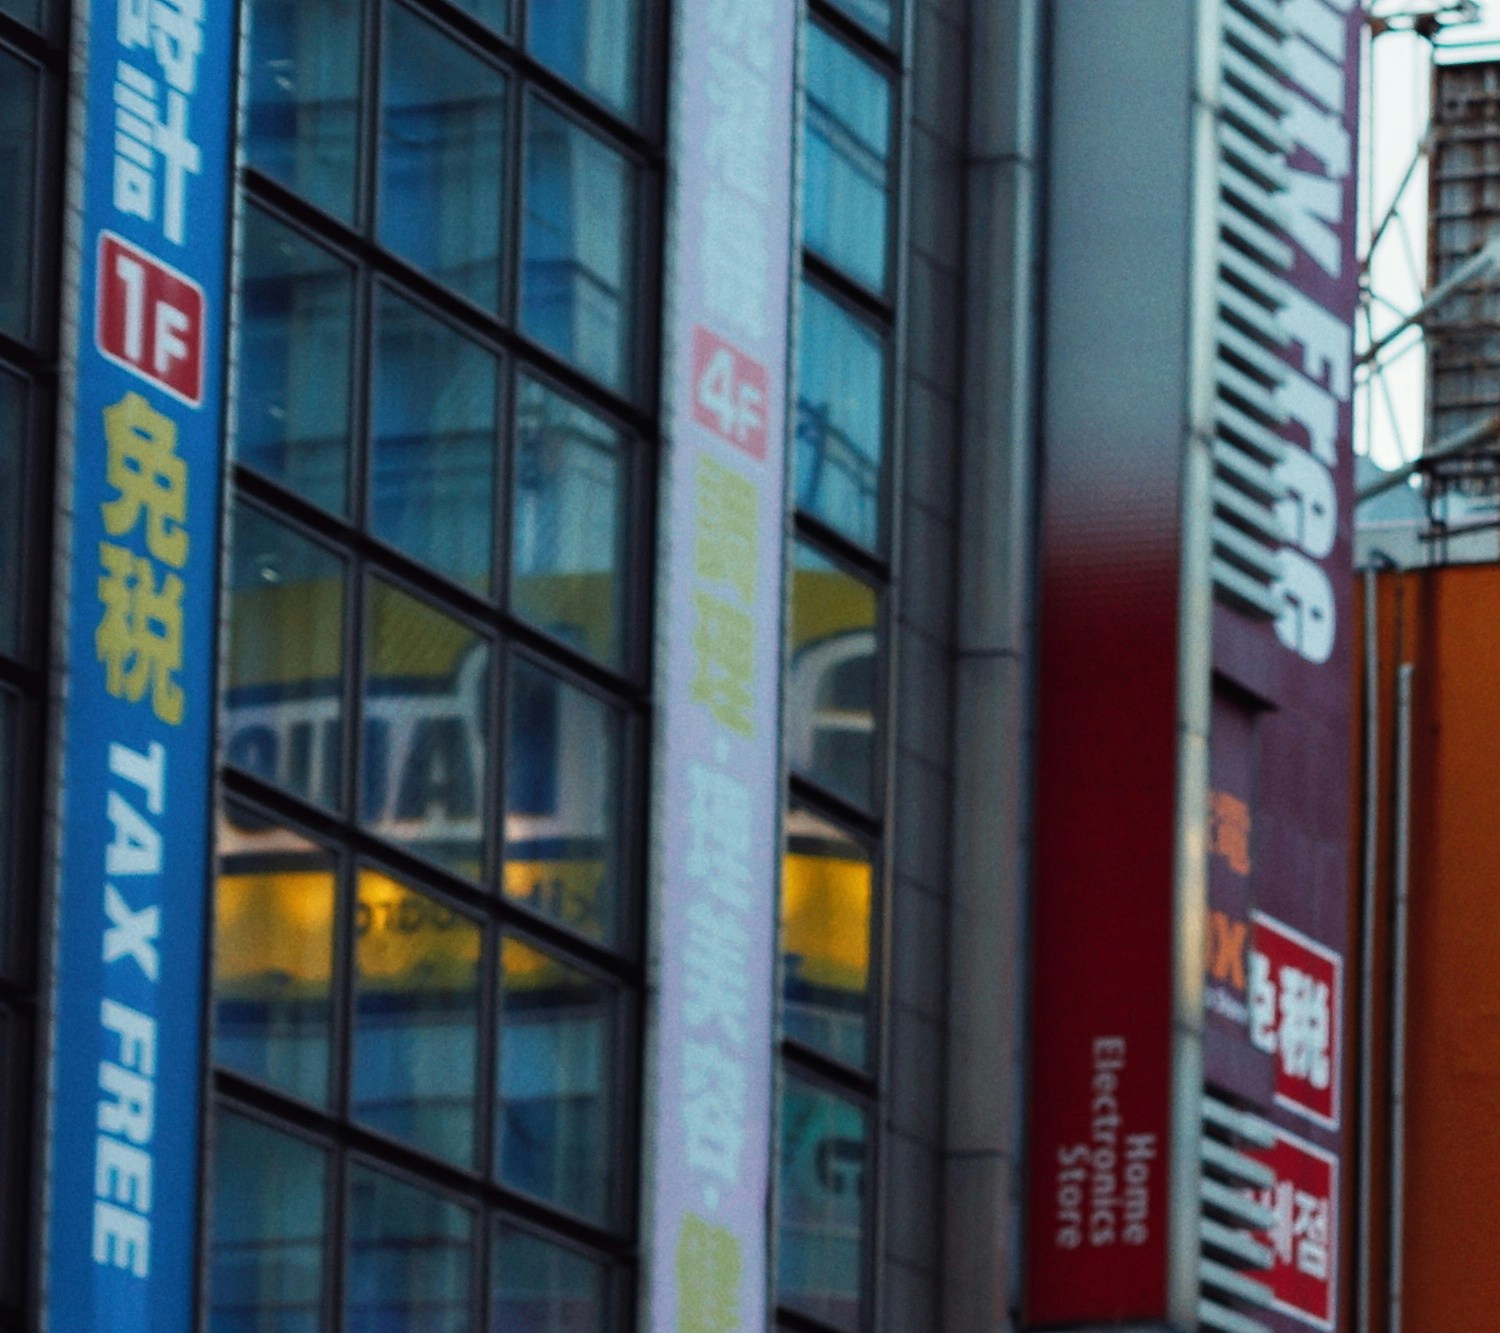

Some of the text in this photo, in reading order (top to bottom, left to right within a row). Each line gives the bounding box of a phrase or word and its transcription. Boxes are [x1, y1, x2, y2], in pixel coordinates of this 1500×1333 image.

[115, 253, 192, 381] 1F
[95, 392, 192, 727] 免税
[1272, 298, 1348, 664] Free
[91, 742, 165, 1279] TAX FREE
[1056, 1143, 1088, 1250] Store
[1090, 1035, 1127, 1248] Electronics
[1122, 1131, 1156, 1247] Home
